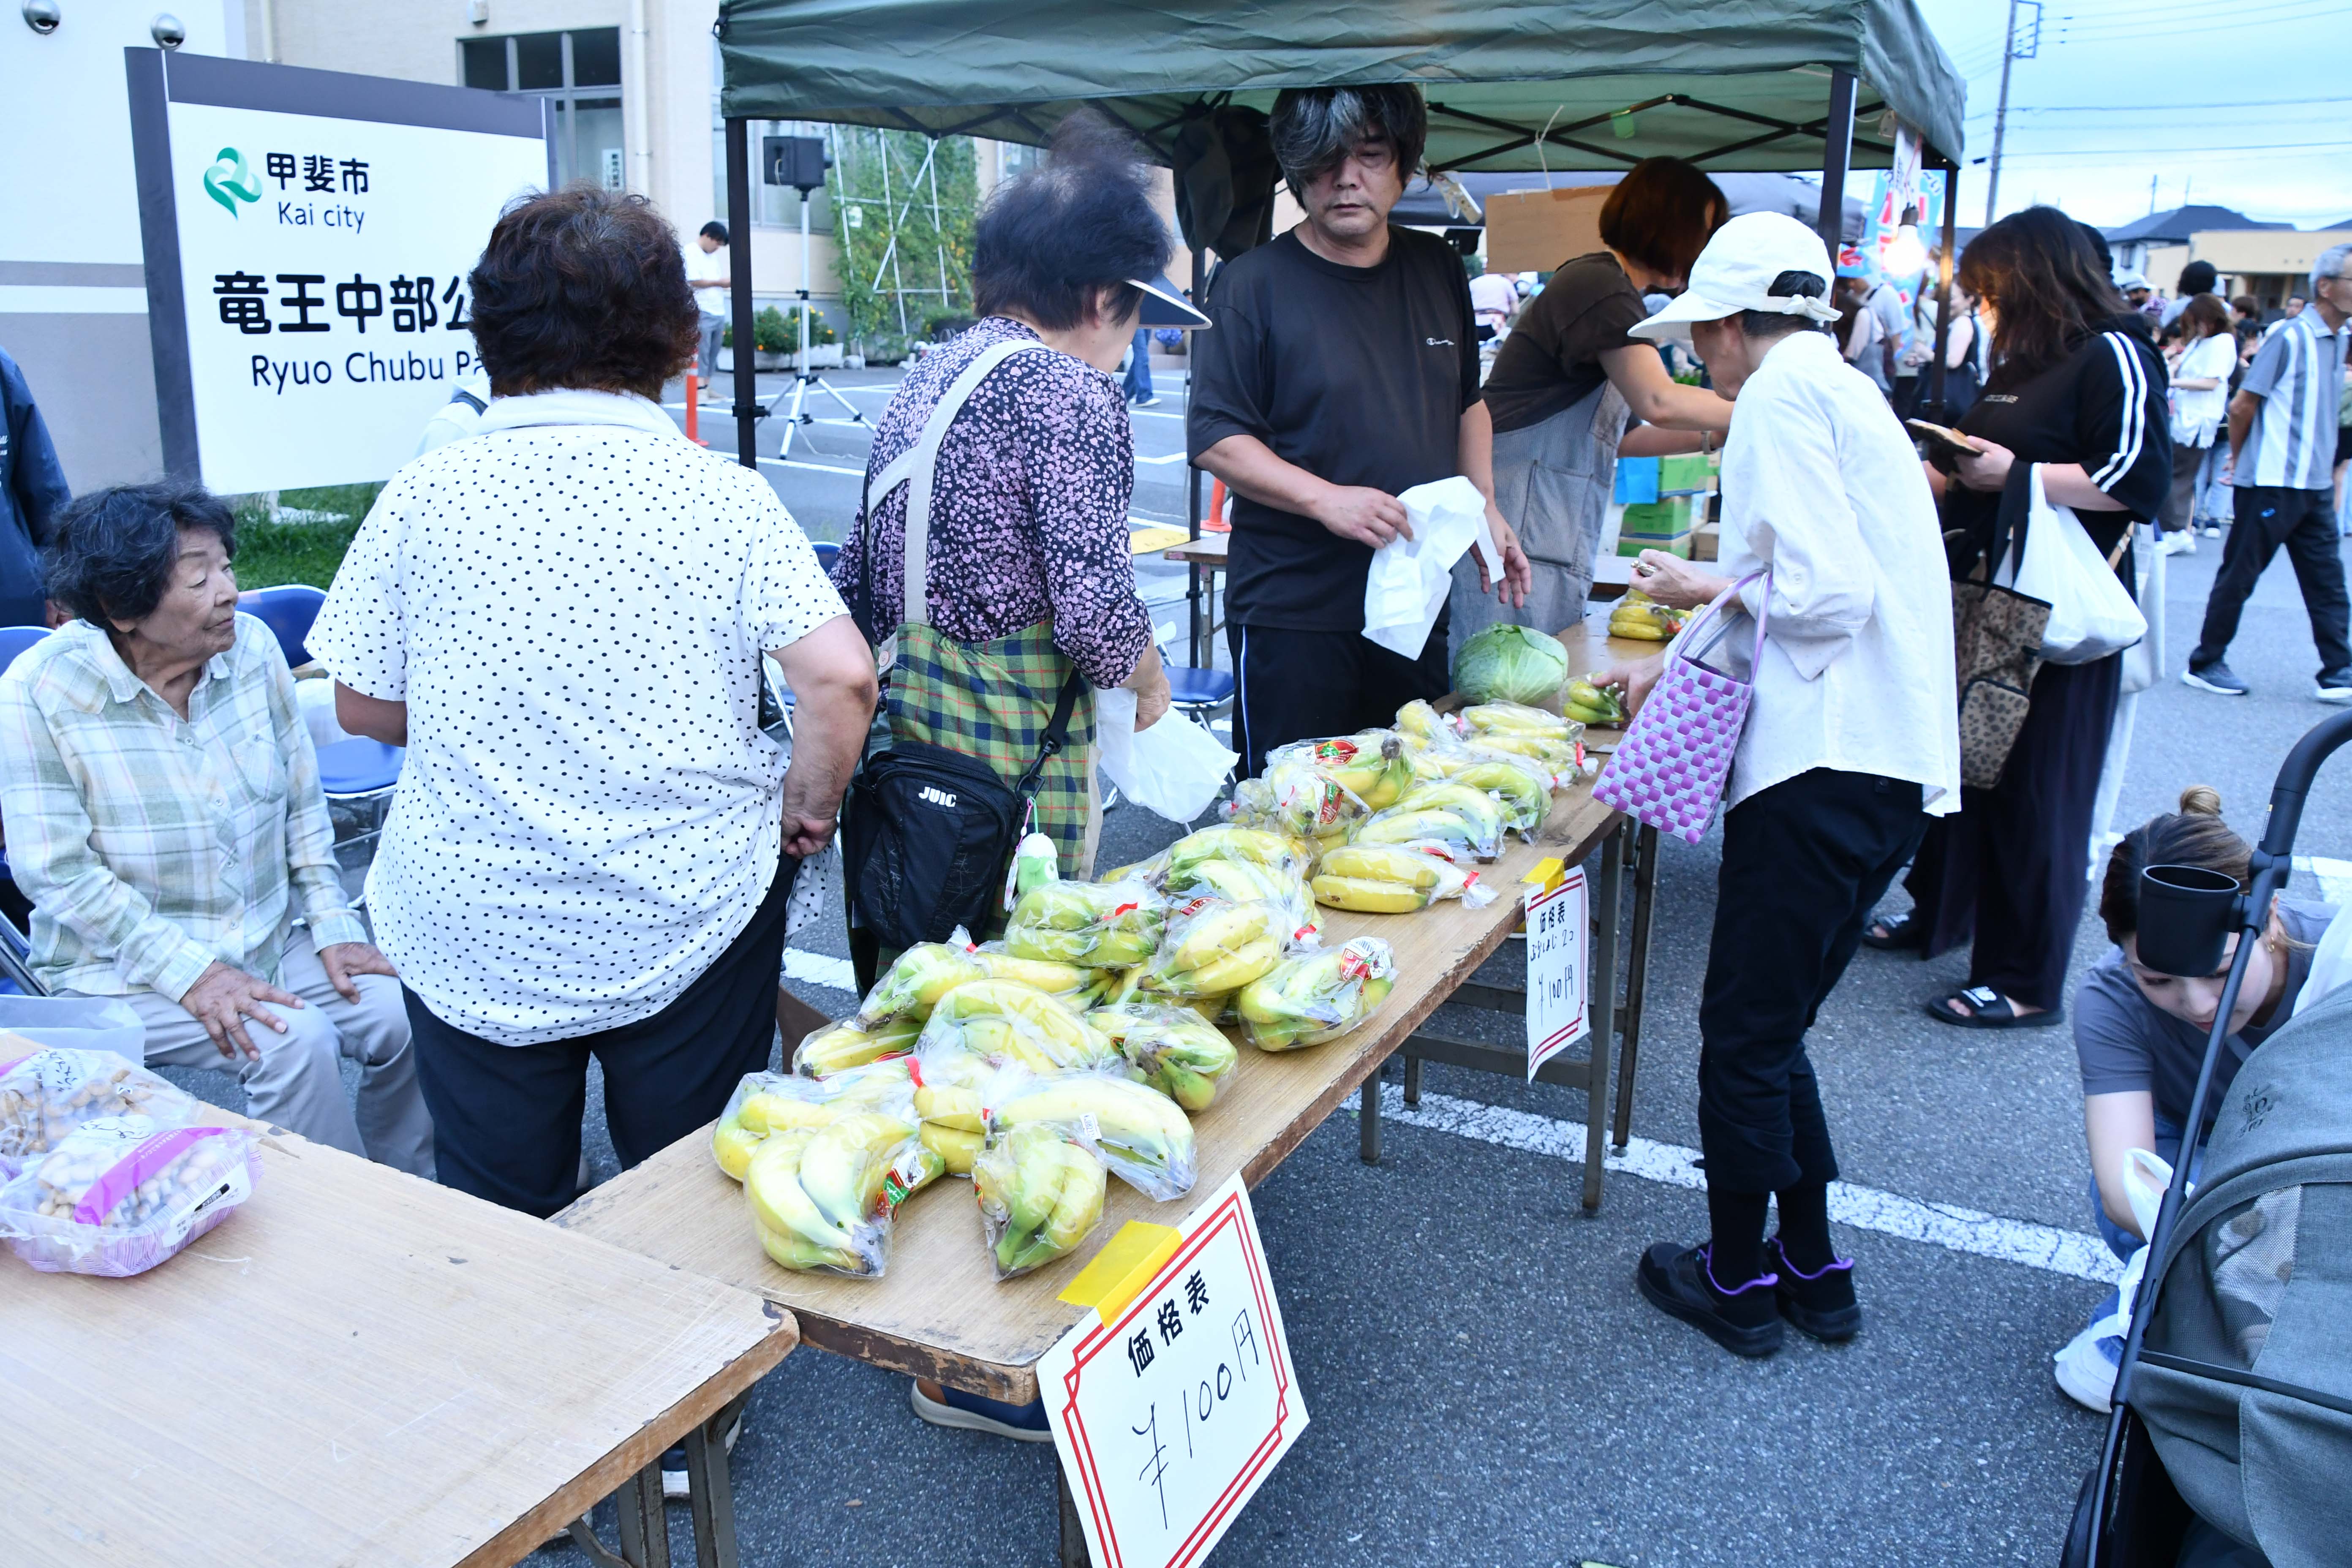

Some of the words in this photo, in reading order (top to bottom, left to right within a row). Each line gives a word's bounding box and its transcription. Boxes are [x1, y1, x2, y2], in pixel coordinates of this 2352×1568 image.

[267, 152, 370, 195] 甲斐市
[278, 201, 314, 226] Kai
[324, 204, 365, 234] city
[251, 354, 332, 395] Ryuo
[345, 350, 444, 383] Chubu
[918, 786, 957, 807] JUIC
[1540, 901, 1565, 936] 価格表
[1127, 1269, 1210, 1378] 価格表
